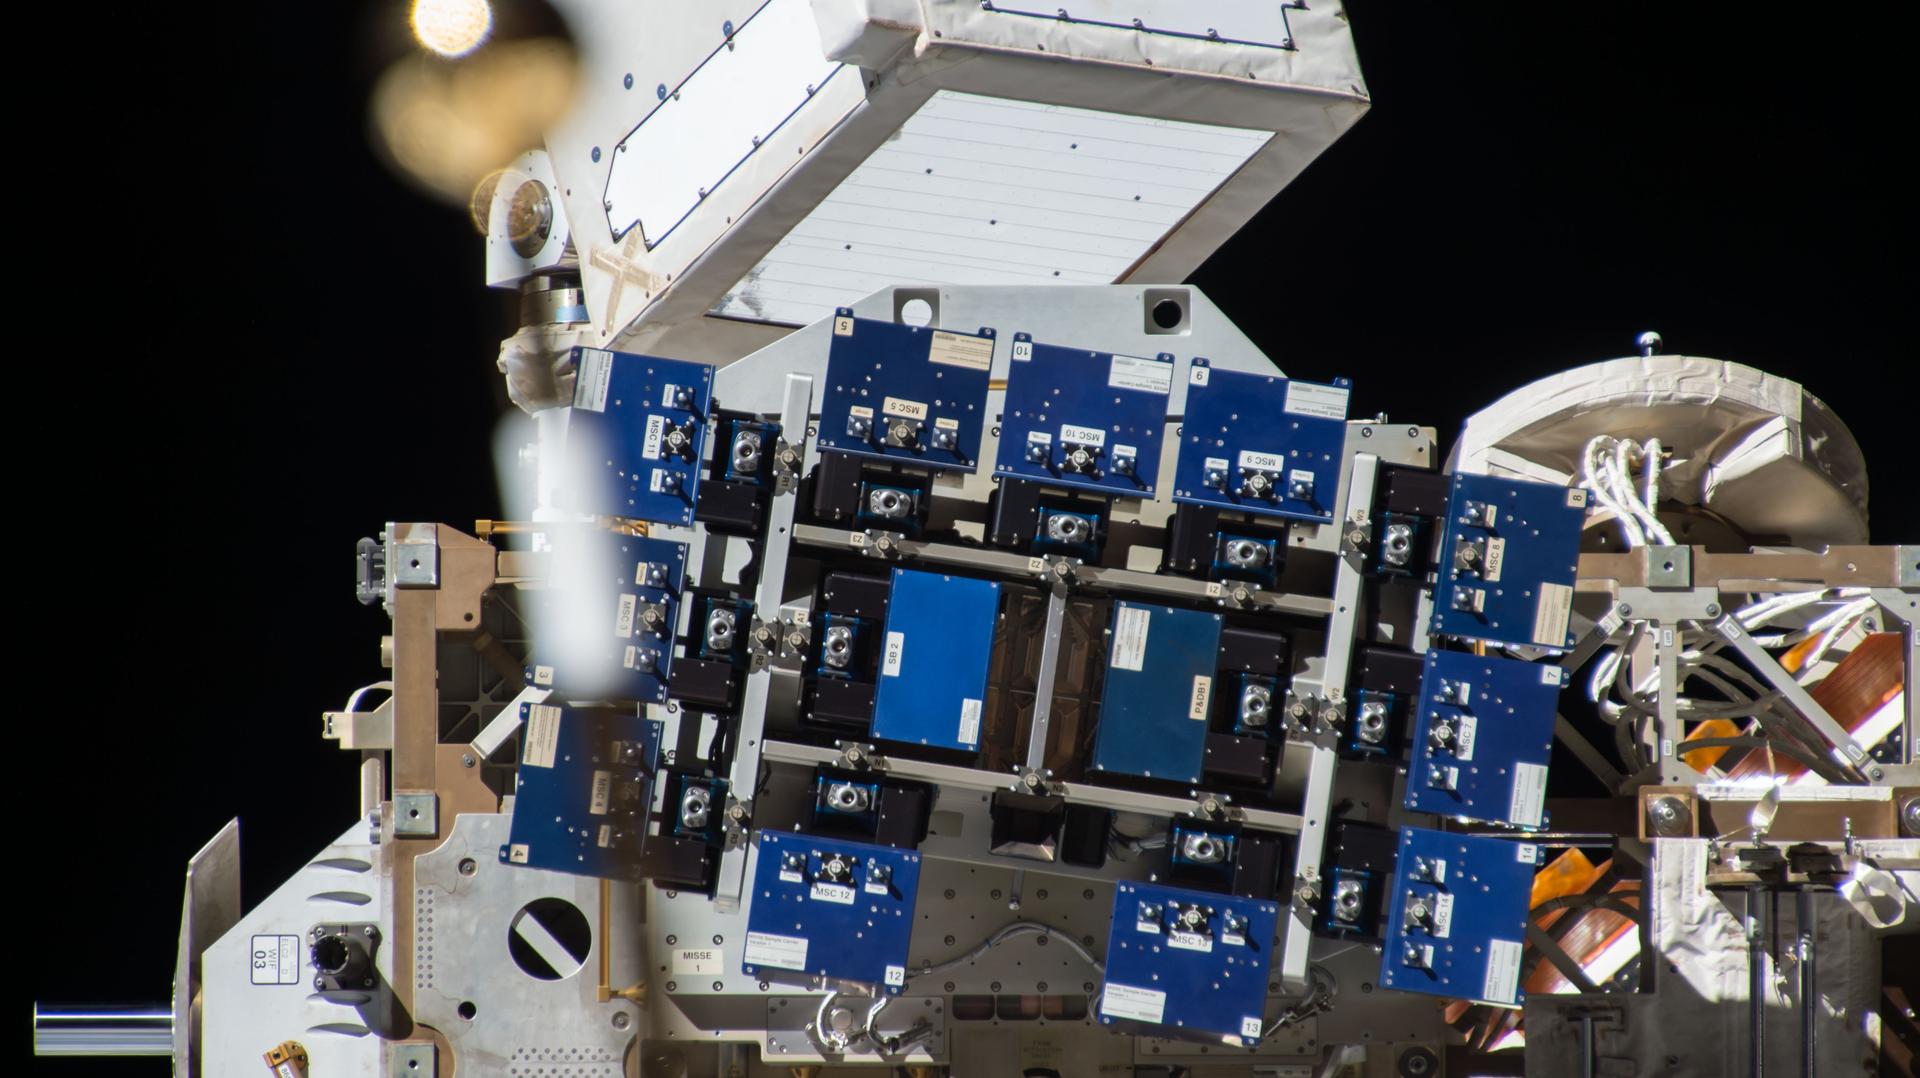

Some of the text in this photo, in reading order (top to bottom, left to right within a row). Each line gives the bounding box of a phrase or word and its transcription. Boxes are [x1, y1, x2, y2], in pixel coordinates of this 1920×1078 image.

[840, 321, 849, 330] 5
[1015, 345, 1031, 357] 10
[890, 402, 921, 415] MSC 5
[648, 419, 661, 456] MSC 11
[1065, 428, 1101, 442] MSC 10
[1247, 454, 1277, 467] MSC 9
[1355, 508, 1365, 522] W3
[1489, 553, 1499, 575] MSC
[622, 601, 632, 621] MSC
[797, 612, 805, 623] A1
[888, 651, 898, 665] SB
[539, 671, 549, 680] 3
[1547, 671, 1556, 679] 7
[1195, 682, 1207, 715] P&DB1
[1331, 687, 1341, 700] W2
[1463, 733, 1472, 754] MSC
[514, 848, 524, 858] 4
[1523, 847, 1533, 859] 14
[1306, 865, 1315, 878] W1
[816, 887, 851, 900] MSC 12
[1440, 897, 1450, 932] MSC 14
[1173, 936, 1209, 949] MSC 13
[254, 950, 266, 969] 03
[268, 949, 277, 970] WIF
[683, 951, 712, 960] MISSE
[889, 971, 901, 982] 12
[1246, 1023, 1258, 1033] 13
